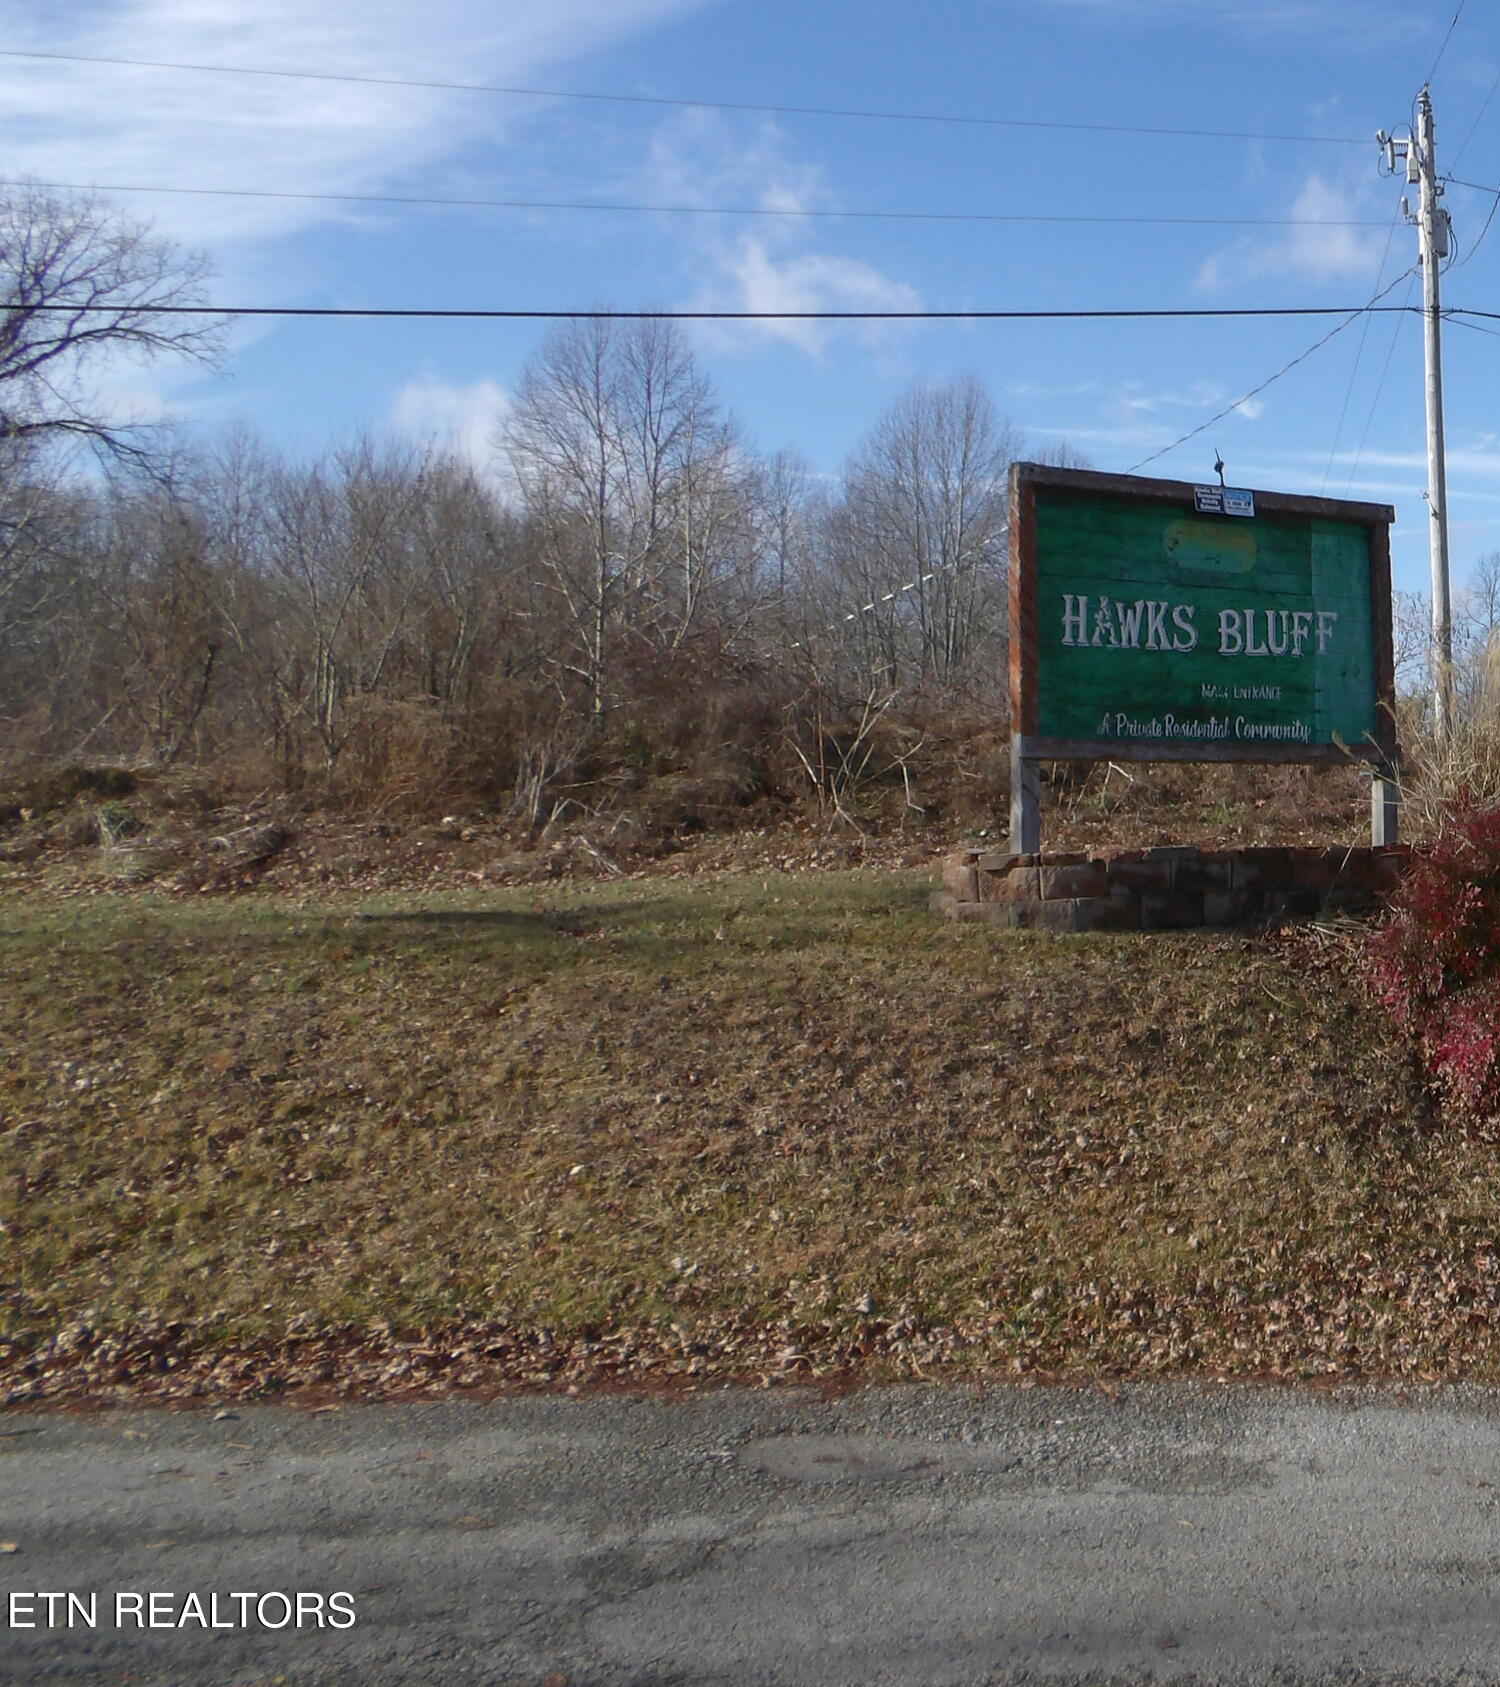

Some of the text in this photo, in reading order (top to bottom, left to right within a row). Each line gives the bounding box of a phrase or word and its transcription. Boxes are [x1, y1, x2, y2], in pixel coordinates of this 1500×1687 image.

[1061, 593, 1339, 658] HAWKS BLUFF
[1201, 683, 1228, 698] MA
[1115, 712, 1163, 737] Private
[1165, 713, 1230, 740] Residential
[1235, 715, 1312, 744] Community
